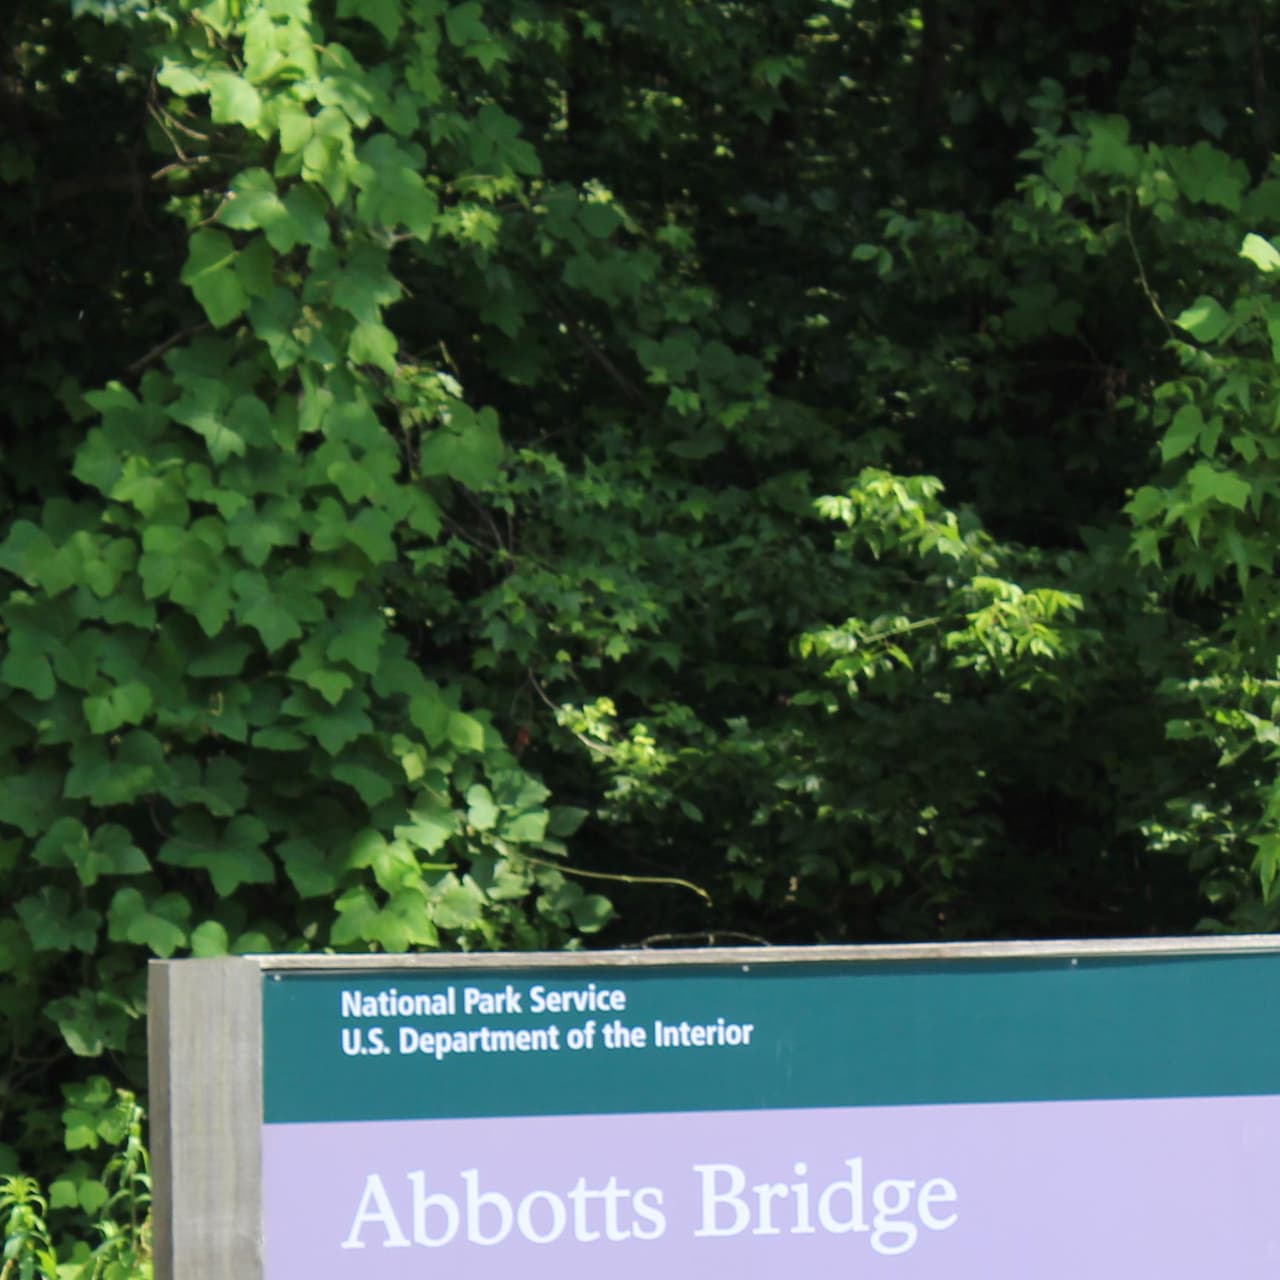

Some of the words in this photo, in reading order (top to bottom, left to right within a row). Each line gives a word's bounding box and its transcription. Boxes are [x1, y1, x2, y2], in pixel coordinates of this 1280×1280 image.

[342, 986, 456, 1018] National
[464, 985, 523, 1015] Park
[529, 983, 627, 1013] Service
[342, 1027, 391, 1056] U.S.
[399, 1024, 560, 1060] Department
[567, 1020, 596, 1050] of
[603, 1020, 647, 1049] the
[654, 1017, 755, 1047] Interior
[341, 1168, 667, 1250] Abbotts
[692, 1156, 959, 1256] Bridge
